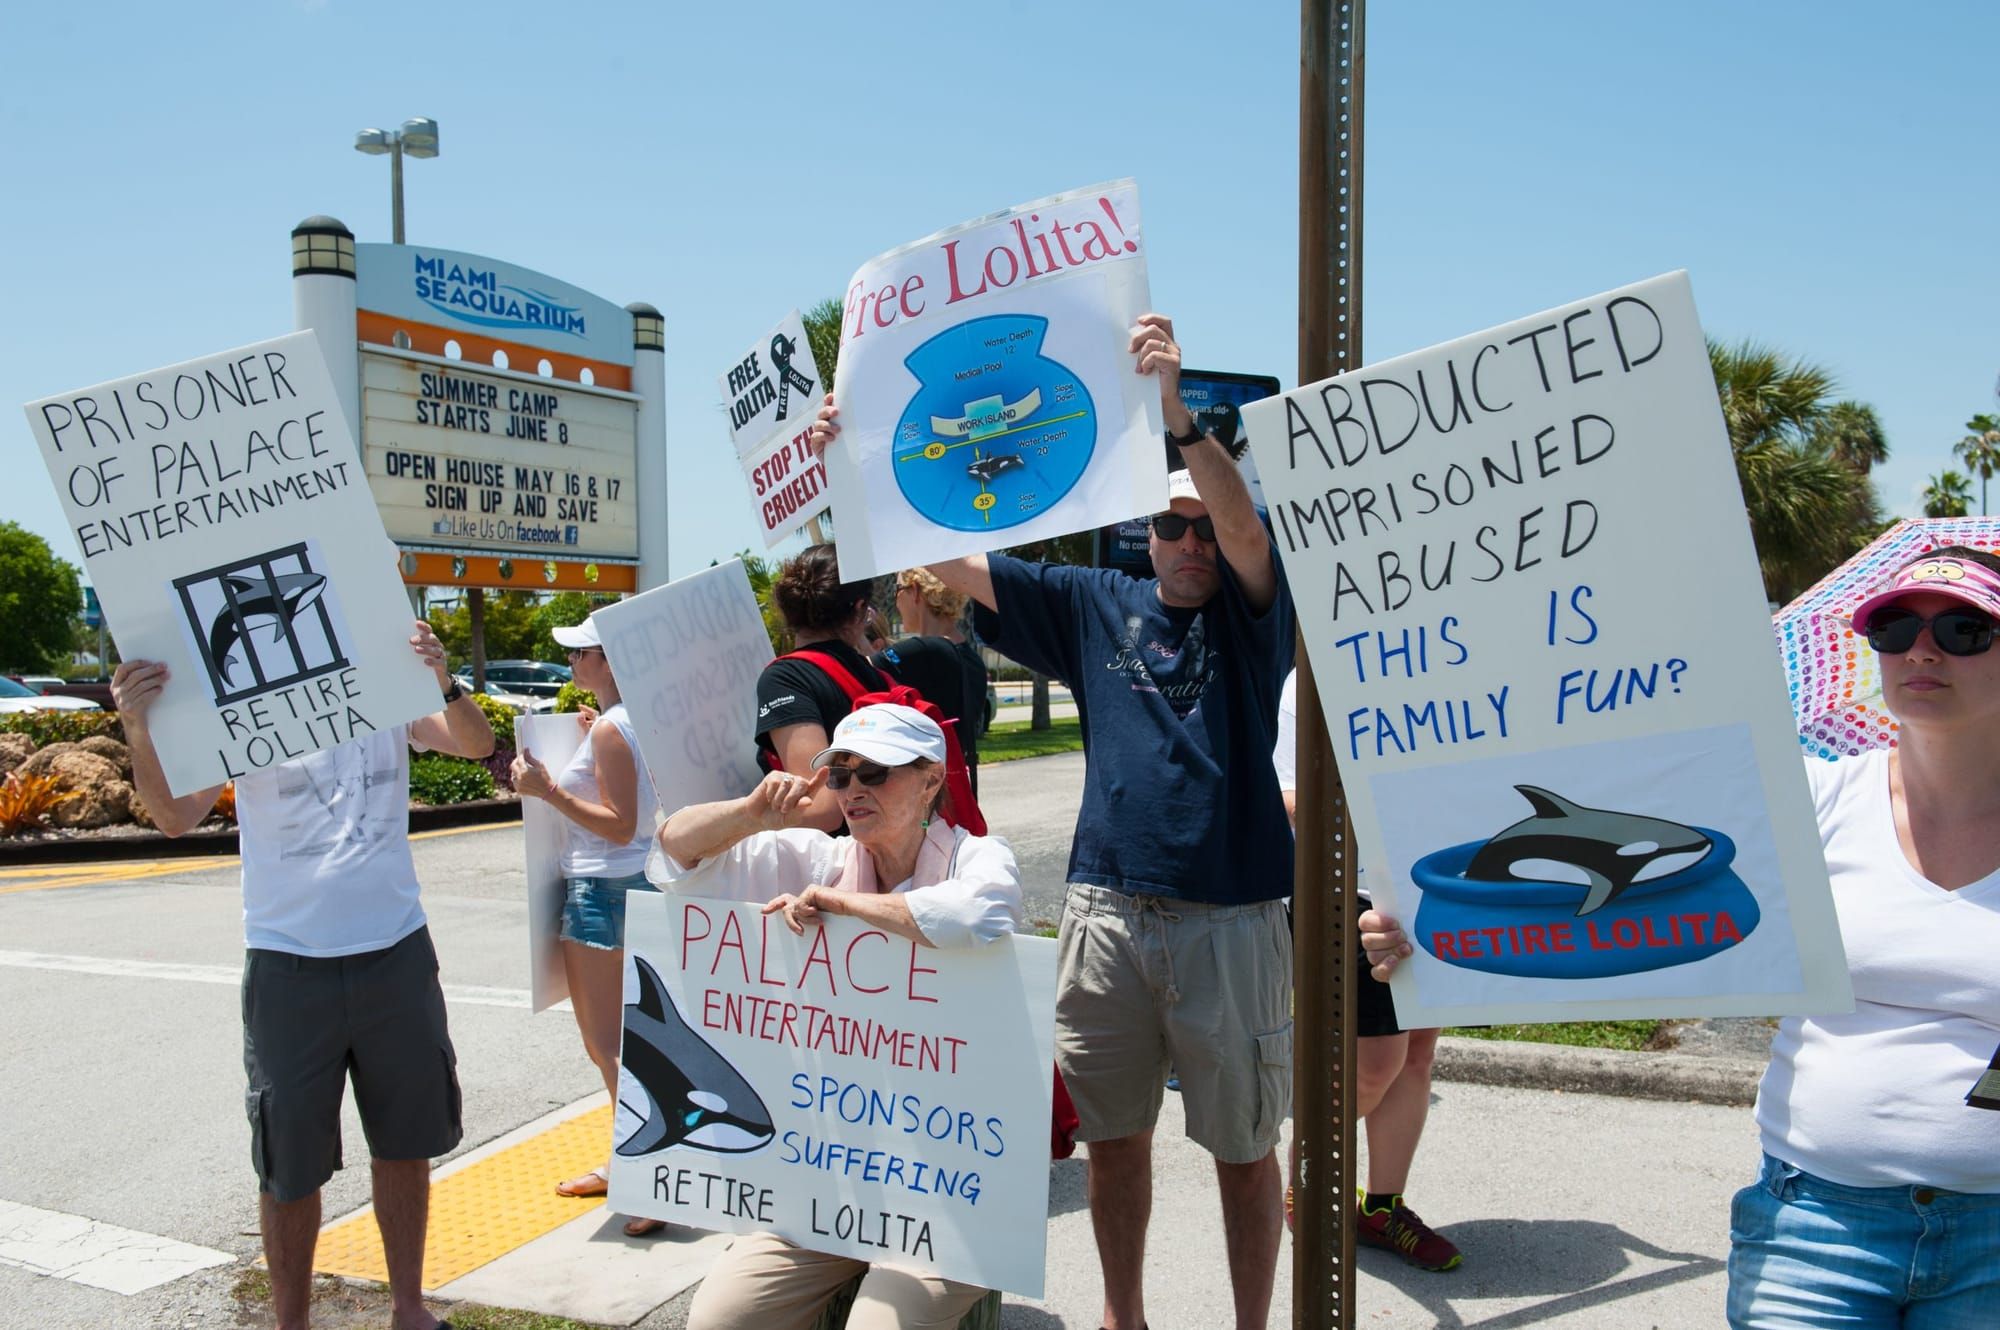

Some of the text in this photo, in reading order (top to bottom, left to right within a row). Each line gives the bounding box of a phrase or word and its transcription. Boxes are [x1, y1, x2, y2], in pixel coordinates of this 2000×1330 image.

[415, 254, 496, 292] MIAMI
[840, 197, 1137, 346] Free Lolita!
[415, 276, 585, 335] SEAQUARIUM
[984, 328, 1034, 348] Water Depth
[41, 352, 297, 452] PRISONER
[421, 373, 558, 418] SUMMER CAMP
[727, 351, 762, 397] FREE
[779, 381, 788, 413] FREE
[789, 370, 810, 393] LOLITA
[954, 361, 1003, 382] Medical Pool
[1055, 383, 1074, 393] Slope
[1055, 392, 1076, 403] Down
[1285, 296, 1664, 470] ABDUCTED
[416, 399, 568, 445] STARTS JUNE 8
[729, 376, 778, 432] LOLITA
[957, 408, 1017, 433] WORK ISLAND
[68, 411, 330, 507] OF PALACE
[753, 425, 816, 497] STOP TH
[1017, 430, 1068, 449] Water Depth
[386, 451, 620, 501] OPEN HOUSE MAY 16 & 17
[425, 484, 598, 524] SIGN UP AND SAVE
[762, 462, 828, 530] CRUELTY
[1276, 414, 1615, 553] IMPRISONED
[77, 463, 349, 559] ENTERTAINMENT
[452, 515, 477, 537] Like
[480, 518, 494, 539] Us
[497, 520, 514, 540] On
[1331, 500, 1599, 621] ABUSED
[1335, 585, 1599, 684] THIS IS
[220, 667, 363, 740] RETIRE
[1347, 659, 1690, 761] FAMILY FUN?
[218, 705, 377, 780] LOLITA
[682, 904, 938, 1003] PALACE
[1433, 912, 1745, 961] RETIRE LOLITA
[703, 989, 968, 1074] ENTERTAINMENT
[791, 1073, 1005, 1158] SPONSORS
[780, 1131, 981, 1206] SUFFERING
[654, 1165, 934, 1262] RETIRE LOLITA
